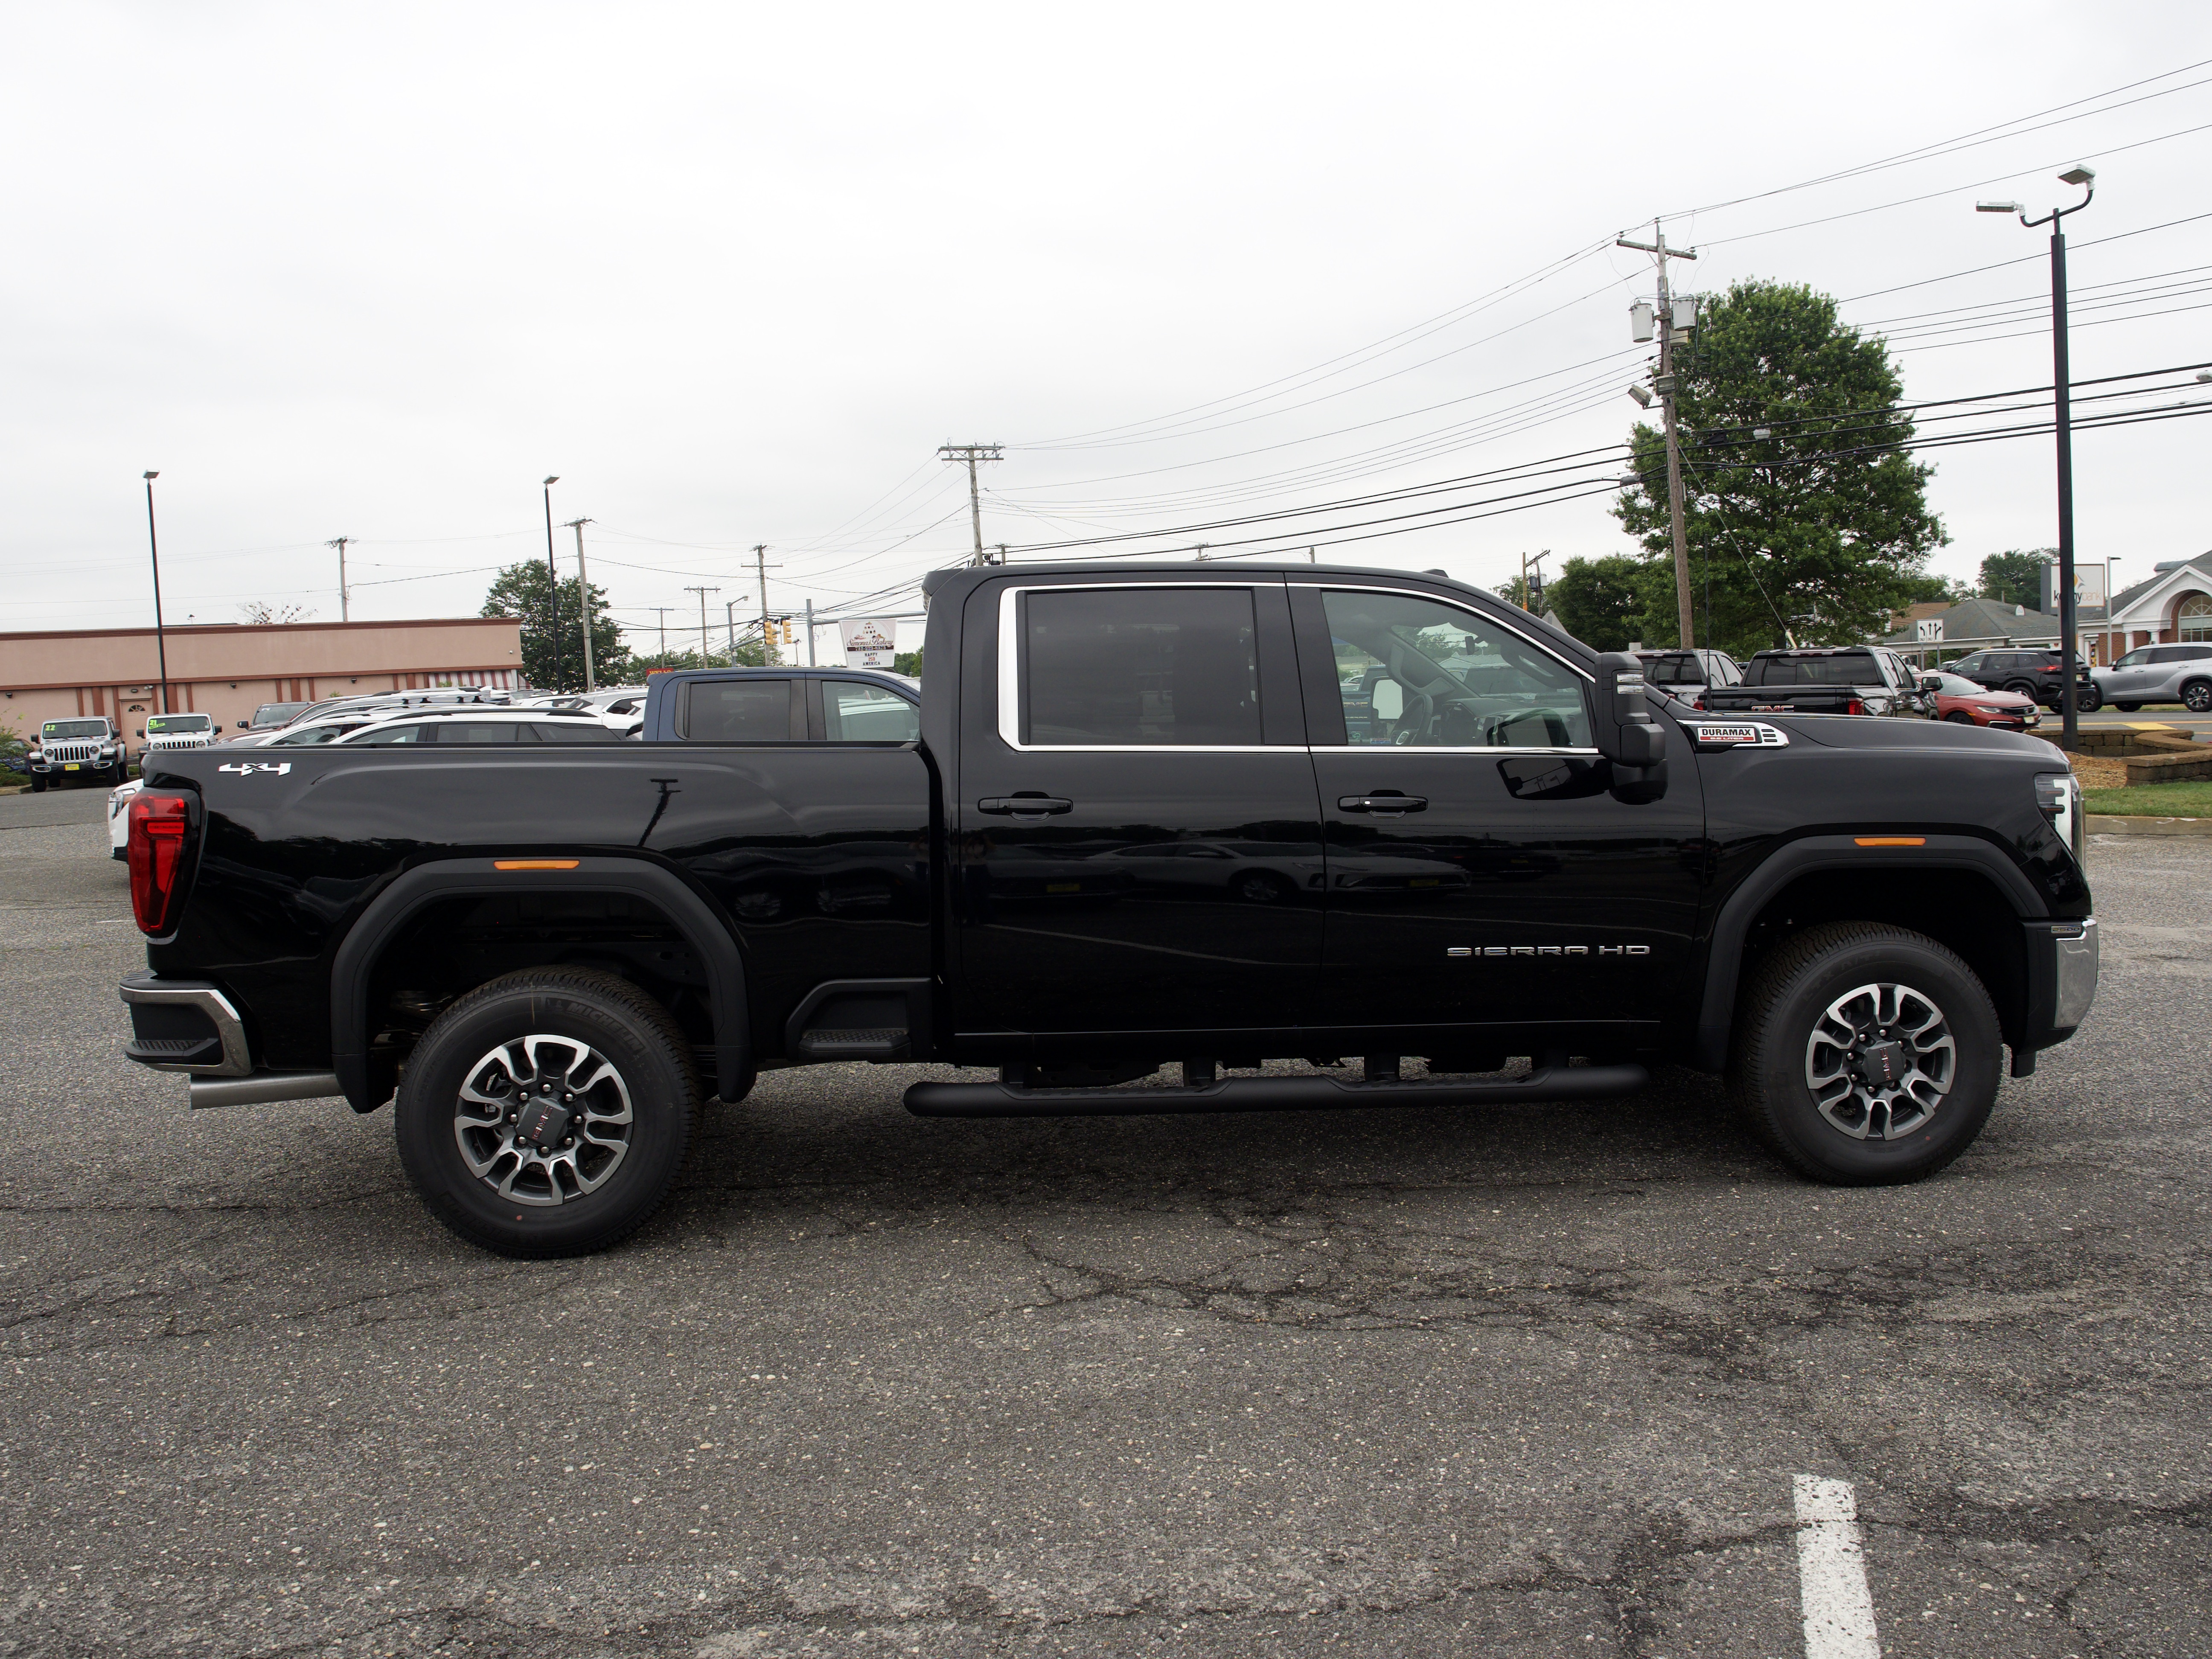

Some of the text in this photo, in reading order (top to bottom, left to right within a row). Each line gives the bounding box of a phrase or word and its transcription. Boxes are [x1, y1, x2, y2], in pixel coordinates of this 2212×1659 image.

[2054, 590, 2102, 604] knybank
[1447, 945, 1650, 956] SIERRA HD
[567, 1002, 644, 1051] MICHELIN
[1880, 1048, 1891, 1080] GMC
[532, 1106, 553, 1139] GMC
